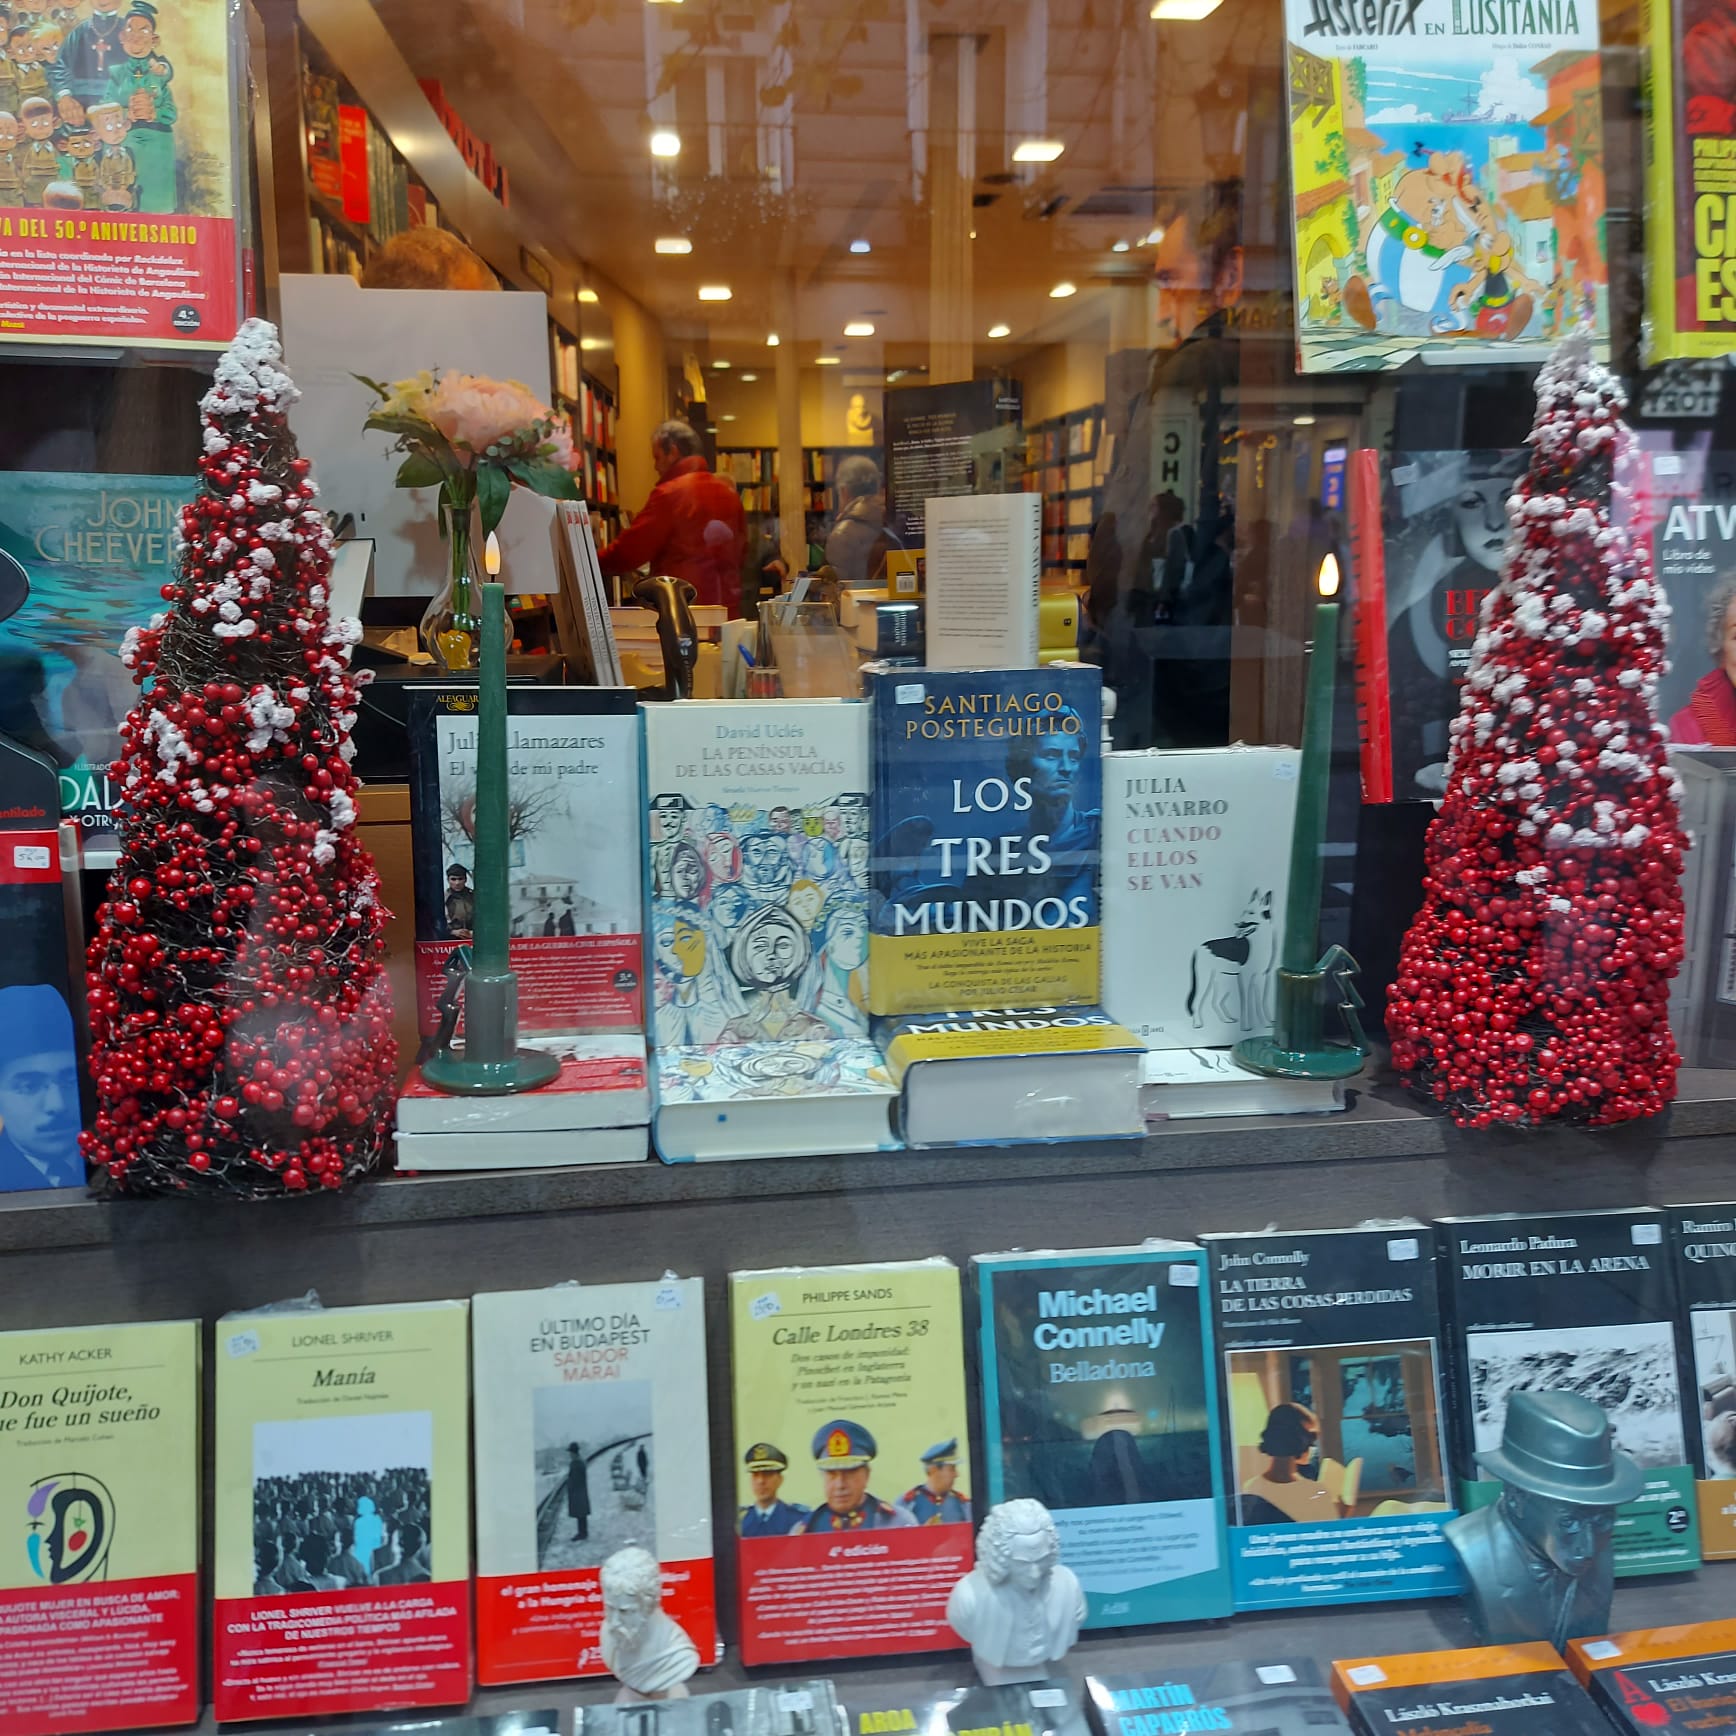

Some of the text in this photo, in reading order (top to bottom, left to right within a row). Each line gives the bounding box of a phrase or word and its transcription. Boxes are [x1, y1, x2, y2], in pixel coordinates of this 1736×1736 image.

[1424, 23, 1444, 35] EN
[19, 218, 48, 238] DEL
[90, 221, 197, 245] ANIVERSARIO
[1662, 548, 1712, 560] Libro de
[1662, 562, 1717, 574] mis vidas
[436, 694, 479, 704] ALFAGUAR
[924, 692, 1063, 716] SANTIAGO
[716, 724, 804, 739] David Uclés
[906, 716, 1082, 741] POSTEGUILLO
[702, 744, 818, 760] LA PENÍNSULA
[450, 760, 599, 779] El de mi padre
[675, 760, 845, 778] DE LAS CASAS VACÍAS
[953, 776, 1033, 814] LOS
[1125, 778, 1187, 798] JULIA
[1125, 799, 1229, 820] NAVARRO
[1127, 826, 1222, 845] CUANDO
[931, 834, 1052, 878] TRES
[1128, 850, 1198, 868] ELLOS
[1128, 872, 1204, 892] SE VAN
[892, 896, 1090, 936] MUNDOS
[962, 936, 1036, 948] VIVE LA SAGA
[904, 944, 1092, 960] MÁS APASIONANTE DE LA HISTORIA
[944, 978, 998, 988] CONQUISTA
[906, 1015, 1114, 1035] MUNDOS
[1460, 1235, 1578, 1254] Leonardo Padura
[1218, 1250, 1311, 1271] John Connolly
[1462, 1255, 1650, 1280] MORIR EN LA ARENA
[1220, 1276, 1307, 1294] LA TIERRA
[802, 1288, 894, 1304] PHILIPPE SANDS
[1038, 1285, 1158, 1318] Michael
[1222, 1288, 1414, 1312] DE LAS COSAS PERDIDAS
[610, 1312, 640, 1330] DÍA
[292, 1330, 394, 1348] LIONEL SHRIVER
[531, 1328, 650, 1352] EN BUDAPEST
[772, 1319, 930, 1346] Calle Londres 38
[1033, 1317, 1166, 1350] Connelly
[19, 1348, 112, 1366] KATHY ACKER
[312, 1366, 376, 1388] Manía
[1049, 1359, 1156, 1384] Belladona
[0, 1384, 134, 1408] Don Quijote,
[24, 1404, 161, 1430] fue un sueño
[844, 1544, 889, 1556] edición
[40, 1598, 74, 1611] MUJER
[77, 1597, 91, 1607] EN
[93, 1594, 128, 1606] BUSCA
[130, 1593, 144, 1602] DE
[250, 1610, 288, 1622] LIONEL
[288, 1606, 332, 1618] SHRIVER
[334, 1602, 371, 1614] VUELVE
[384, 1600, 398, 1610] LA
[398, 1598, 434, 1608] CARGA
[6, 1612, 48, 1624] AUTORA
[50, 1609, 98, 1621] VISCERAL
[101, 1608, 109, 1616] Y
[60, 1620, 90, 1630] COMO
[92, 1613, 164, 1628] APASIONANTE
[227, 1606, 457, 1634] CON LA TRAGICOMEDIA POLÍTICA MÁS AFILADA
[284, 1622, 401, 1640] DE NUESTROS TIEMPOS
[1108, 1681, 1196, 1712] MARTÍN
